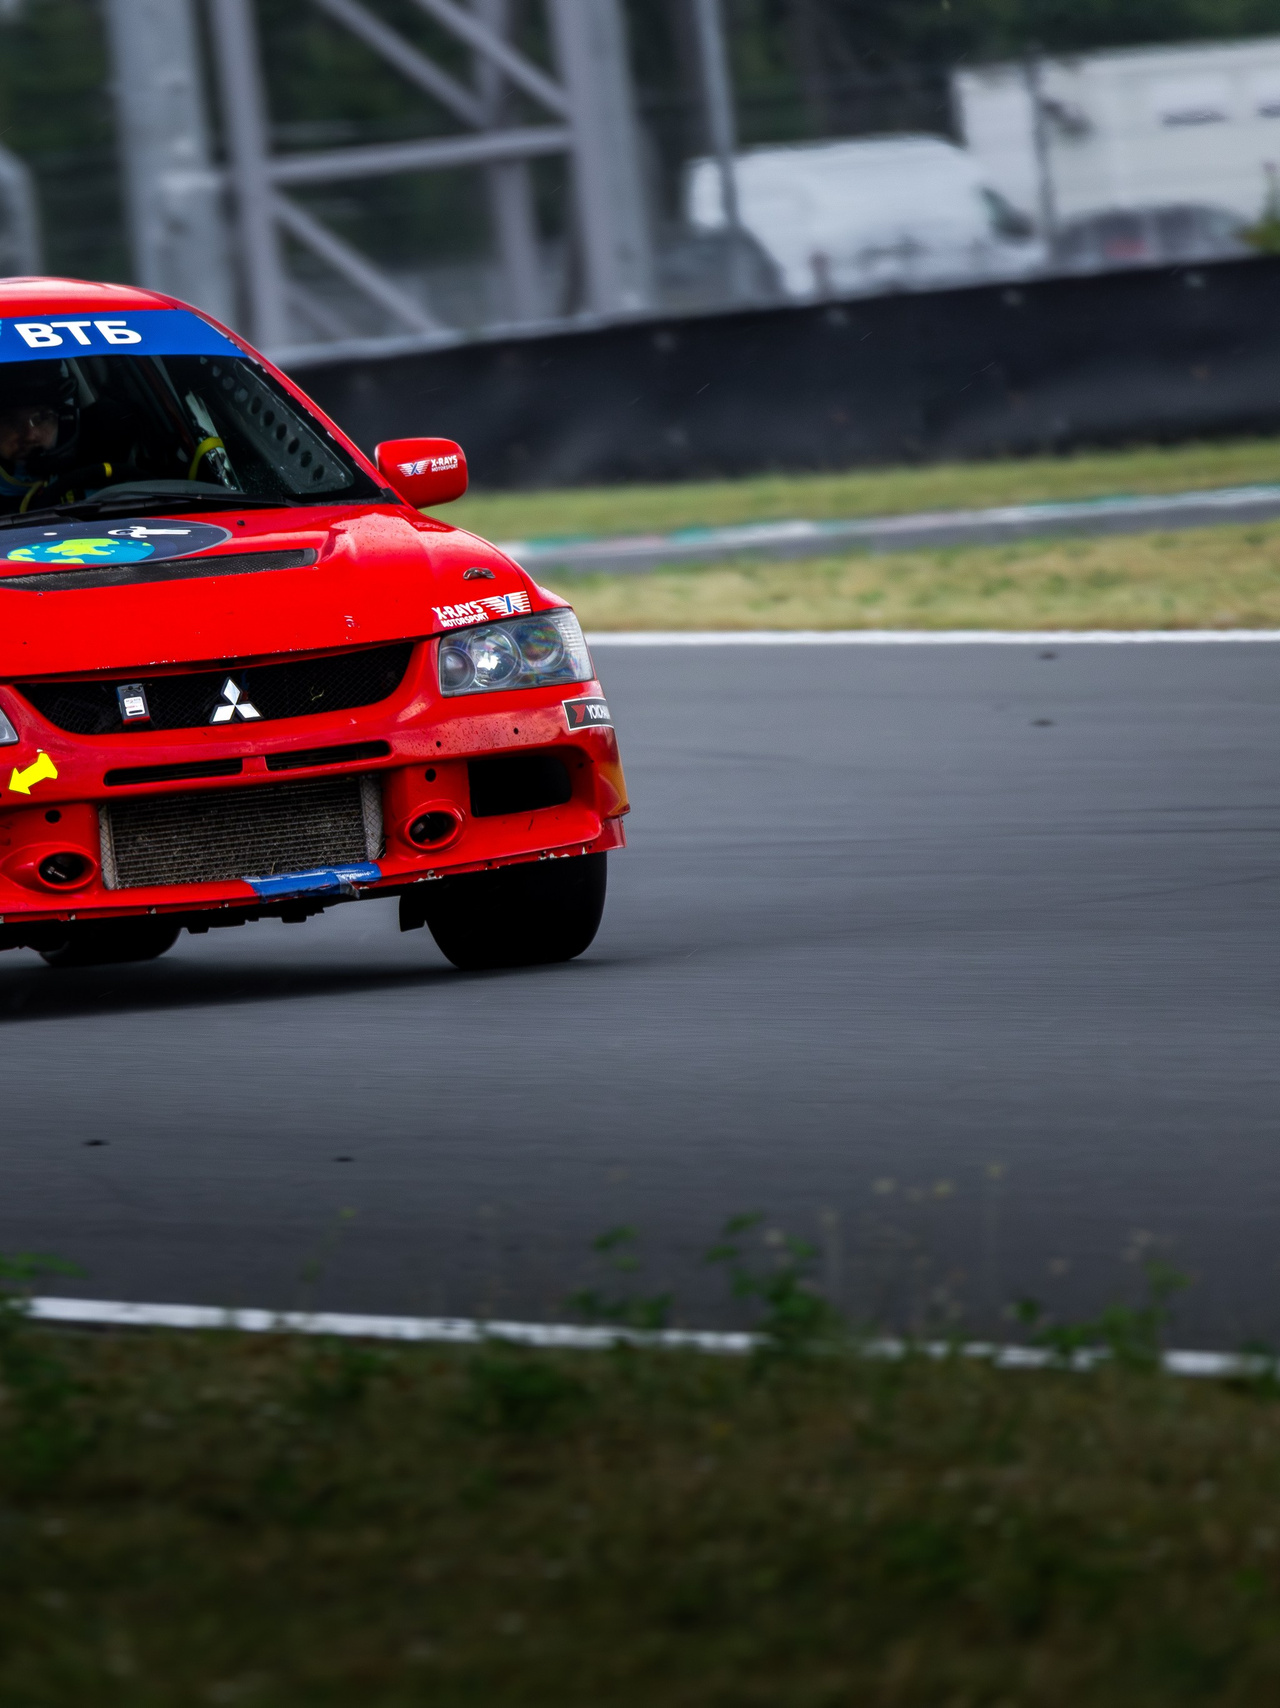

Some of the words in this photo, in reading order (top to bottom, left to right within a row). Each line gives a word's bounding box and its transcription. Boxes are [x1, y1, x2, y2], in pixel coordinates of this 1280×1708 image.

[14, 320, 142, 349] ВТБ
[440, 612, 489, 628] MOTORSPORT
[586, 704, 610, 719] YOKOH
